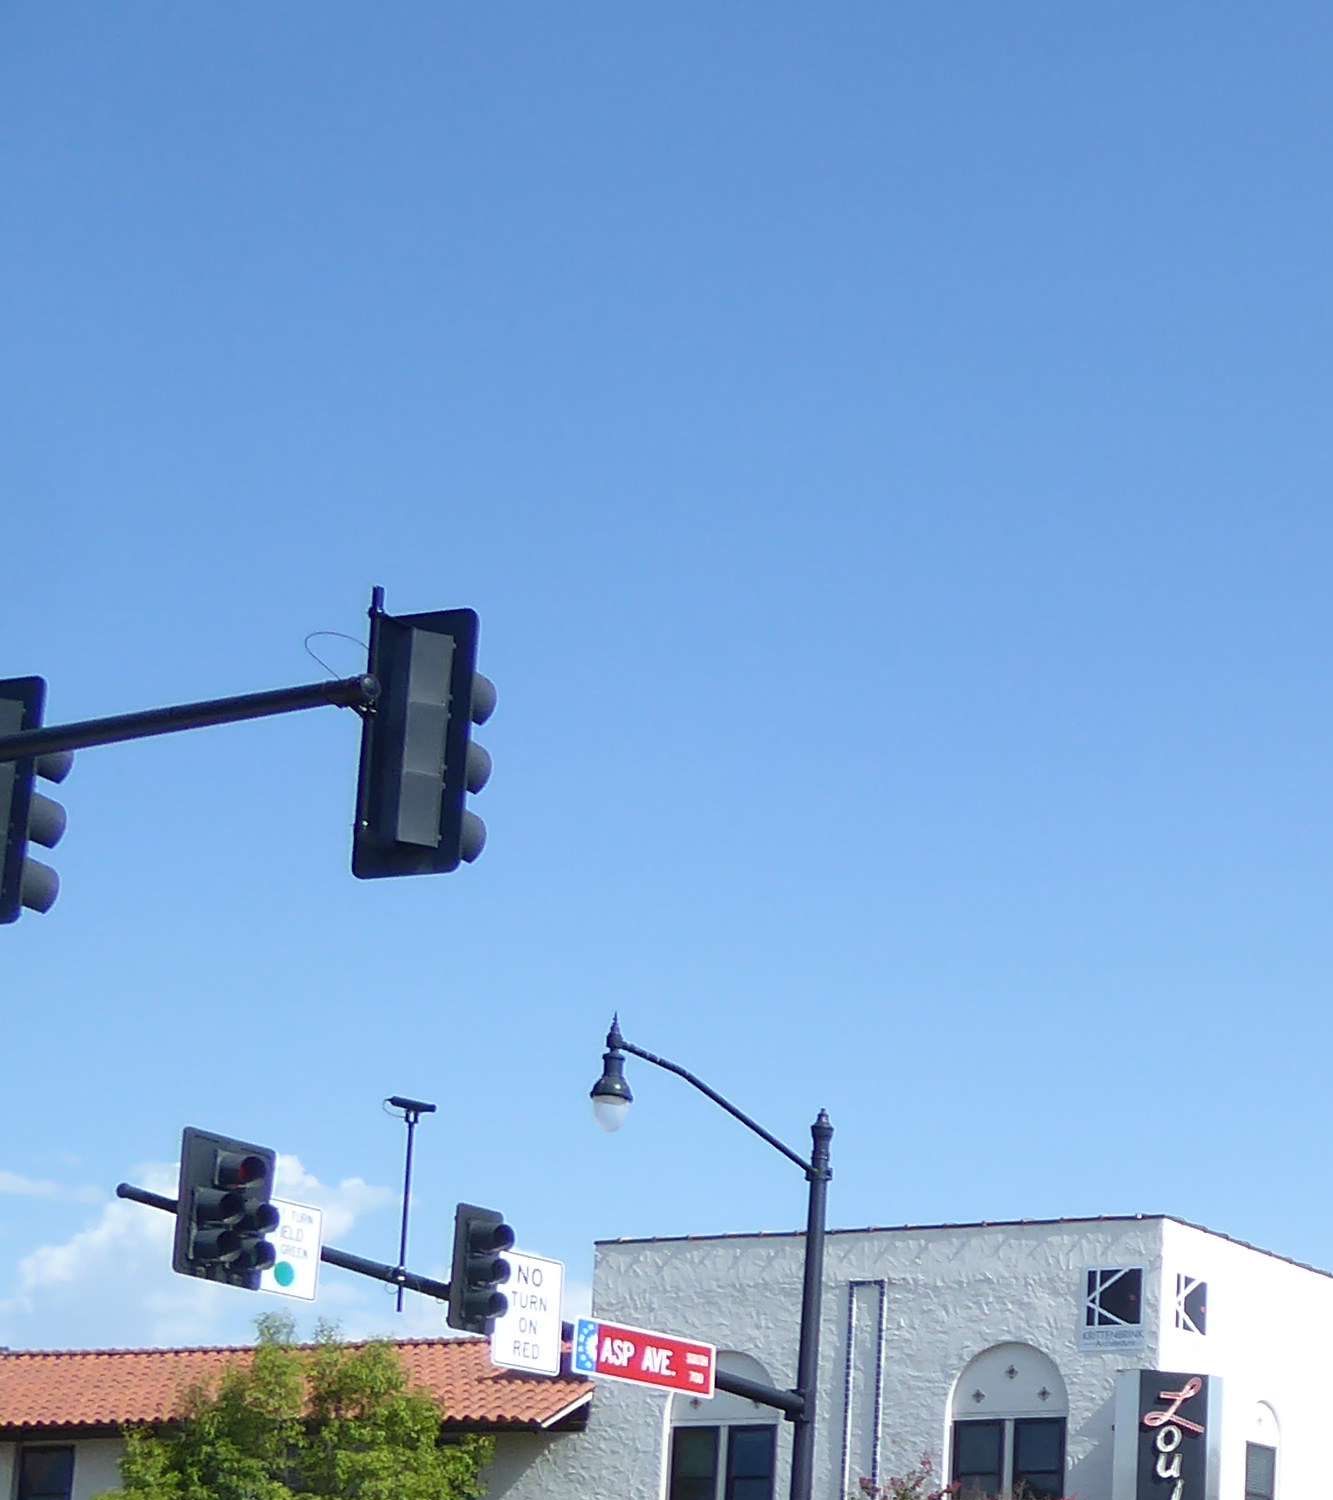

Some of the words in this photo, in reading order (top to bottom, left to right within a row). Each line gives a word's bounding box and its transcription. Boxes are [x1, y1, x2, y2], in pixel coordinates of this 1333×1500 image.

[280, 1225, 304, 1242] IELD
[516, 1264, 543, 1288] NO
[511, 1290, 548, 1313] TURN
[518, 1317, 538, 1335] ON
[513, 1339, 540, 1360] RED
[601, 1336, 635, 1367] ASP
[641, 1345, 677, 1377] AVE.
